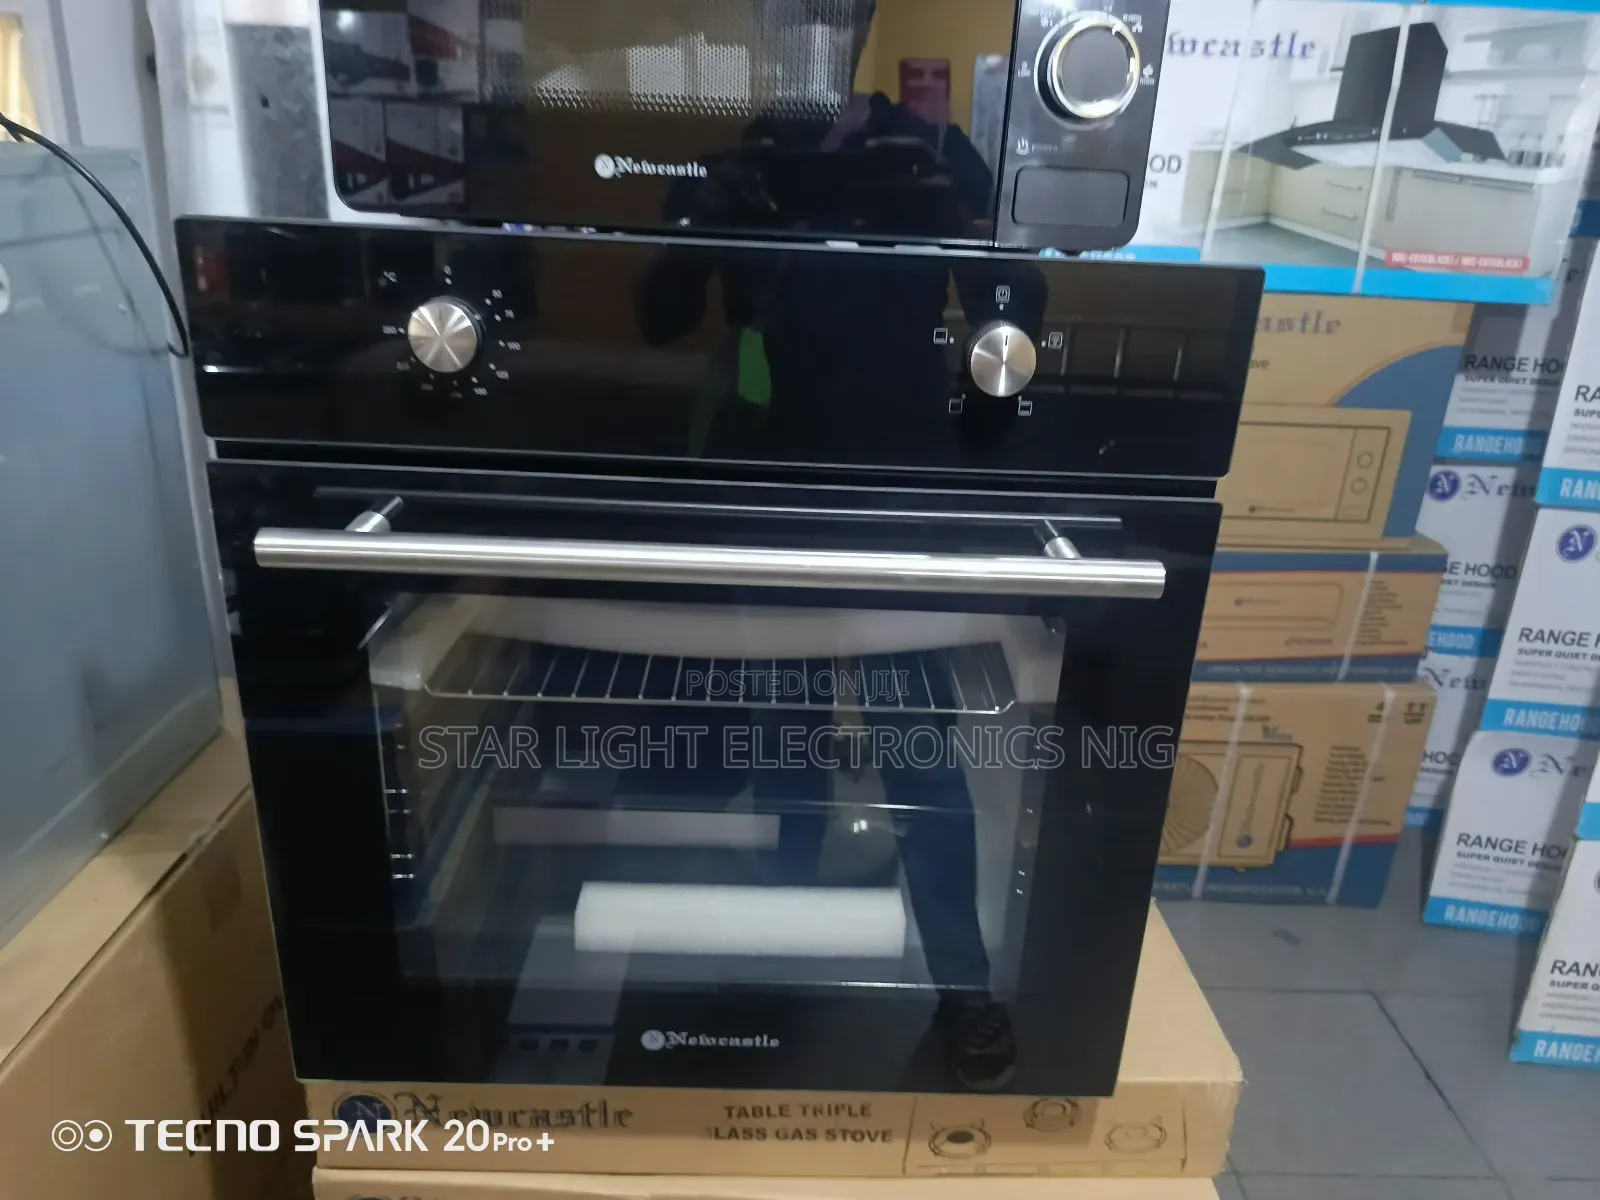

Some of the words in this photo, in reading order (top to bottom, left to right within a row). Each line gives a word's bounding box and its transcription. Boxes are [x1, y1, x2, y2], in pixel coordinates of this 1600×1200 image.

[614, 155, 708, 178] Newcastle
[1464, 354, 1529, 373] RANGE
[1464, 561, 1518, 579] HOOD
[1518, 627, 1592, 648] RANGE
[1517, 648, 1553, 657] SUPER
[1554, 651, 1588, 660] QUIET
[1456, 832, 1528, 855] RANGE
[1456, 851, 1490, 861] SUPER
[1493, 855, 1525, 866] QUIET
[1550, 959, 1600, 978] RAN
[1549, 979, 1589, 990] SUPER
[665, 1030, 780, 1049] Newcastle
[393, 1090, 634, 1129] Newcastle
[723, 1103, 791, 1119] TABLE
[800, 1102, 873, 1118] TRIPLE
[775, 1126, 818, 1142] GAS
[825, 1127, 893, 1144] STOVE
